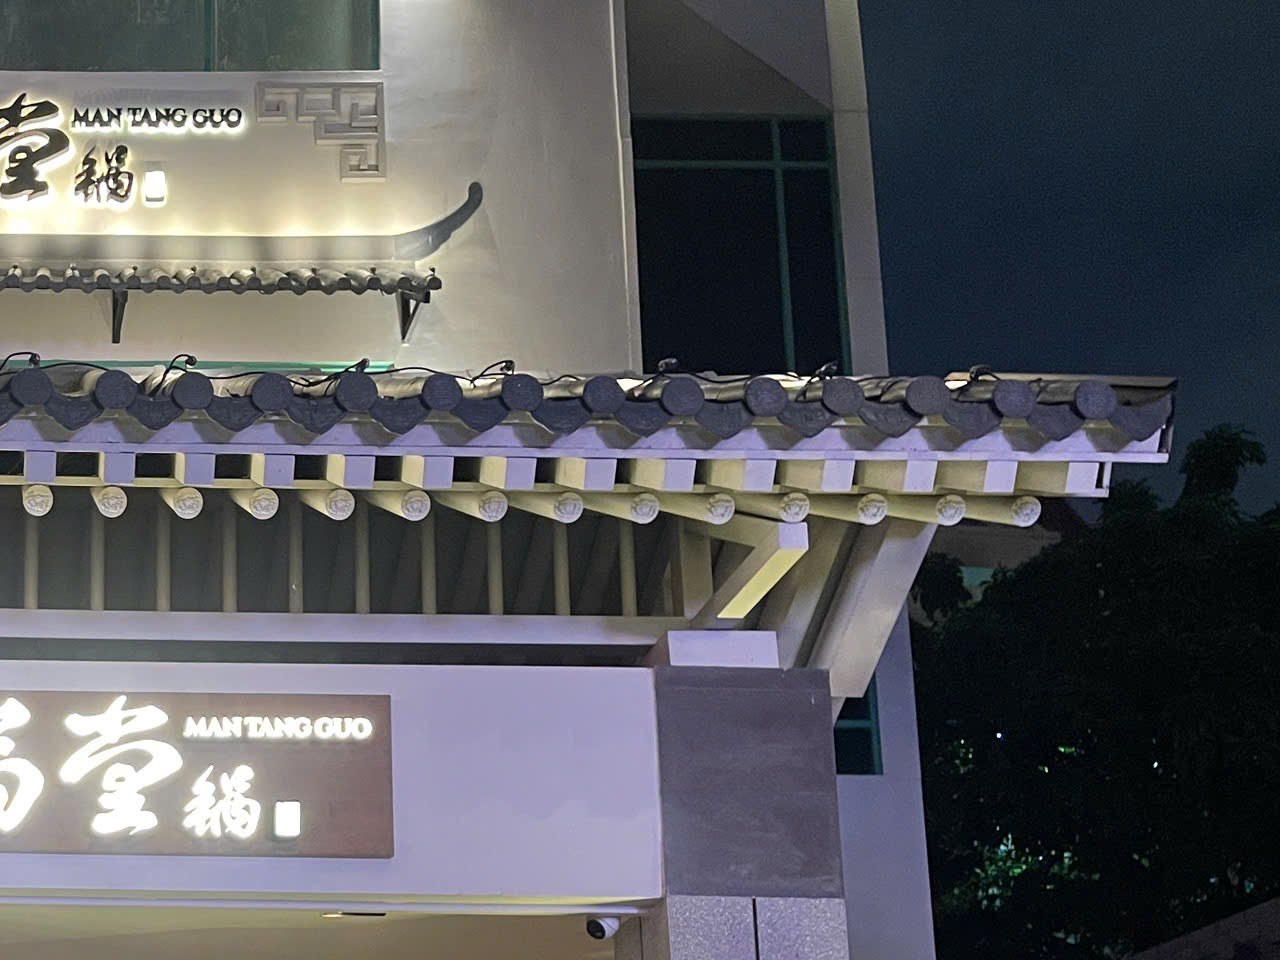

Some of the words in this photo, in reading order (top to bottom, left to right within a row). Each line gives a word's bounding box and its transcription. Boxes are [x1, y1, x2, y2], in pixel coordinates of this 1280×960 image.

[72, 107, 122, 128] MAN
[127, 107, 187, 128] TANG
[192, 107, 242, 129] GUO
[183, 716, 242, 738] MAN
[244, 716, 313, 739] TANG
[314, 717, 373, 740] GUO
